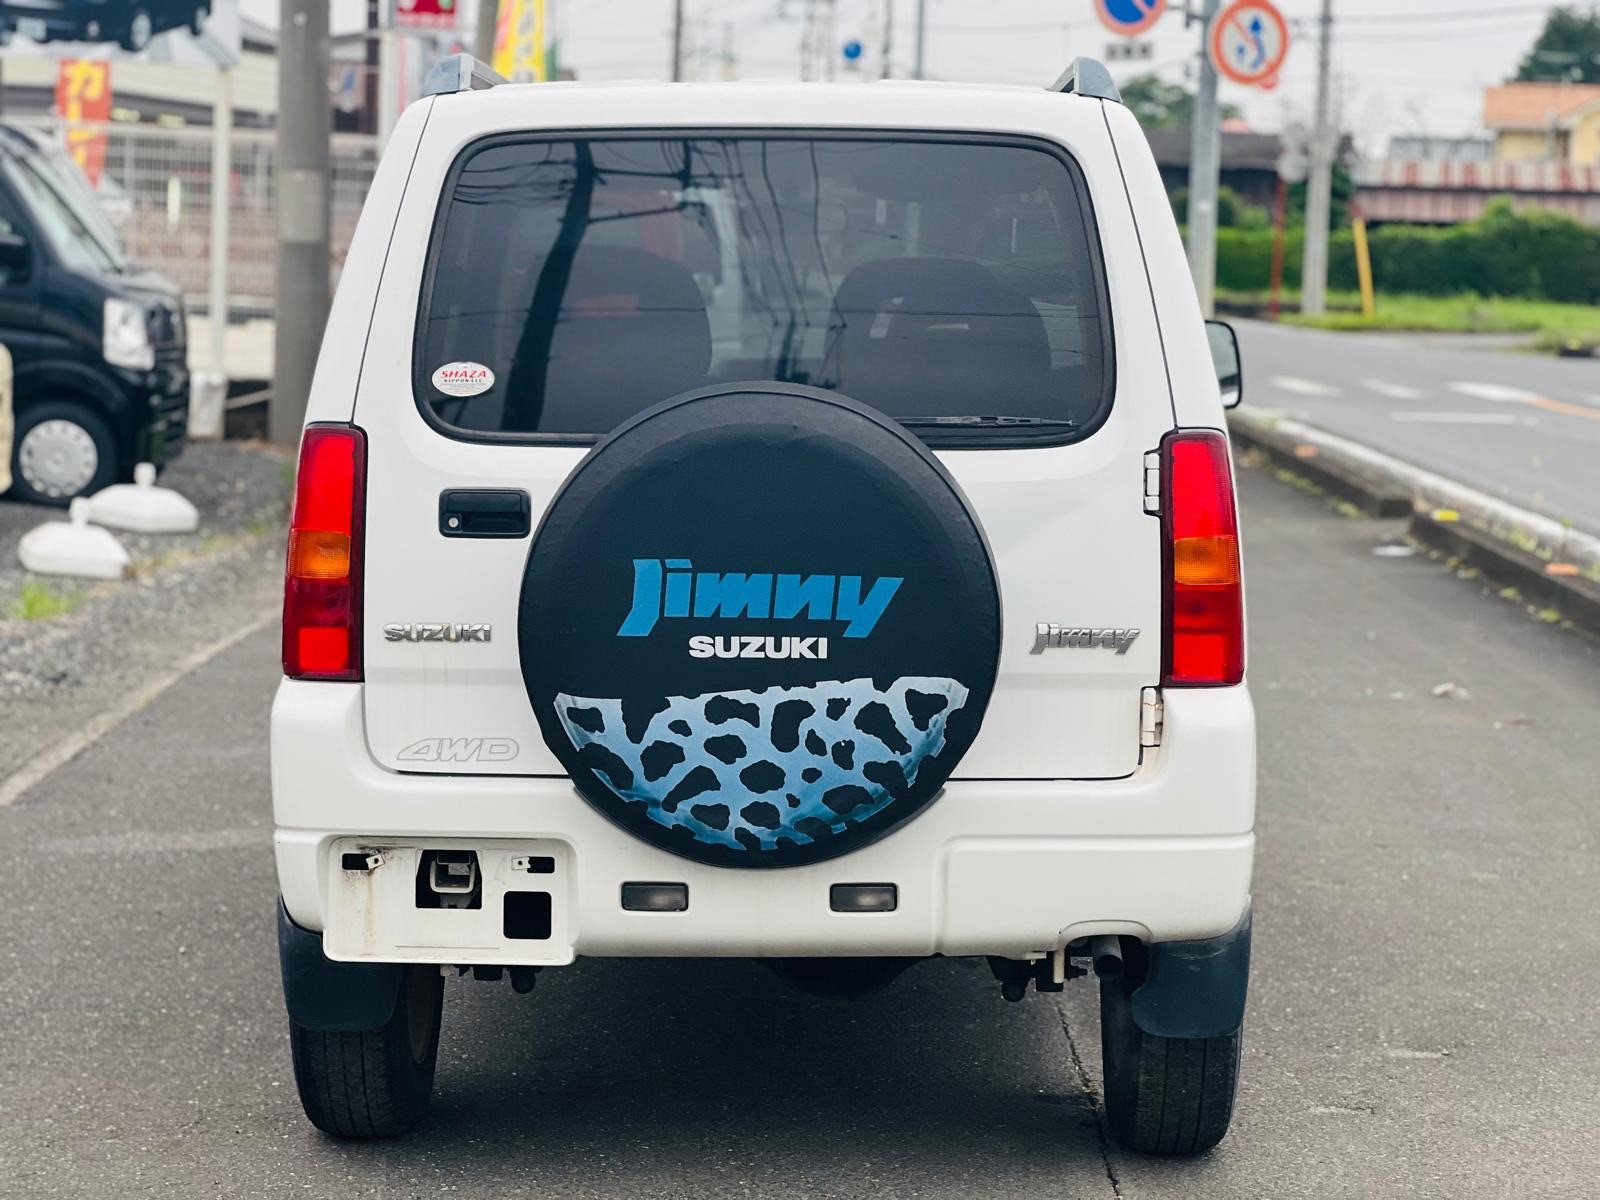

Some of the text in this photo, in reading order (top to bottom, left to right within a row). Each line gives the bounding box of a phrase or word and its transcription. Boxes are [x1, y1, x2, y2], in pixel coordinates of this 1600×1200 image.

[441, 369, 487, 379] SHAZA
[616, 558, 904, 638] Jimmy
[384, 623, 492, 642] SUZUKI
[688, 635, 828, 659] SUZUKI
[396, 737, 520, 762] 4WD
